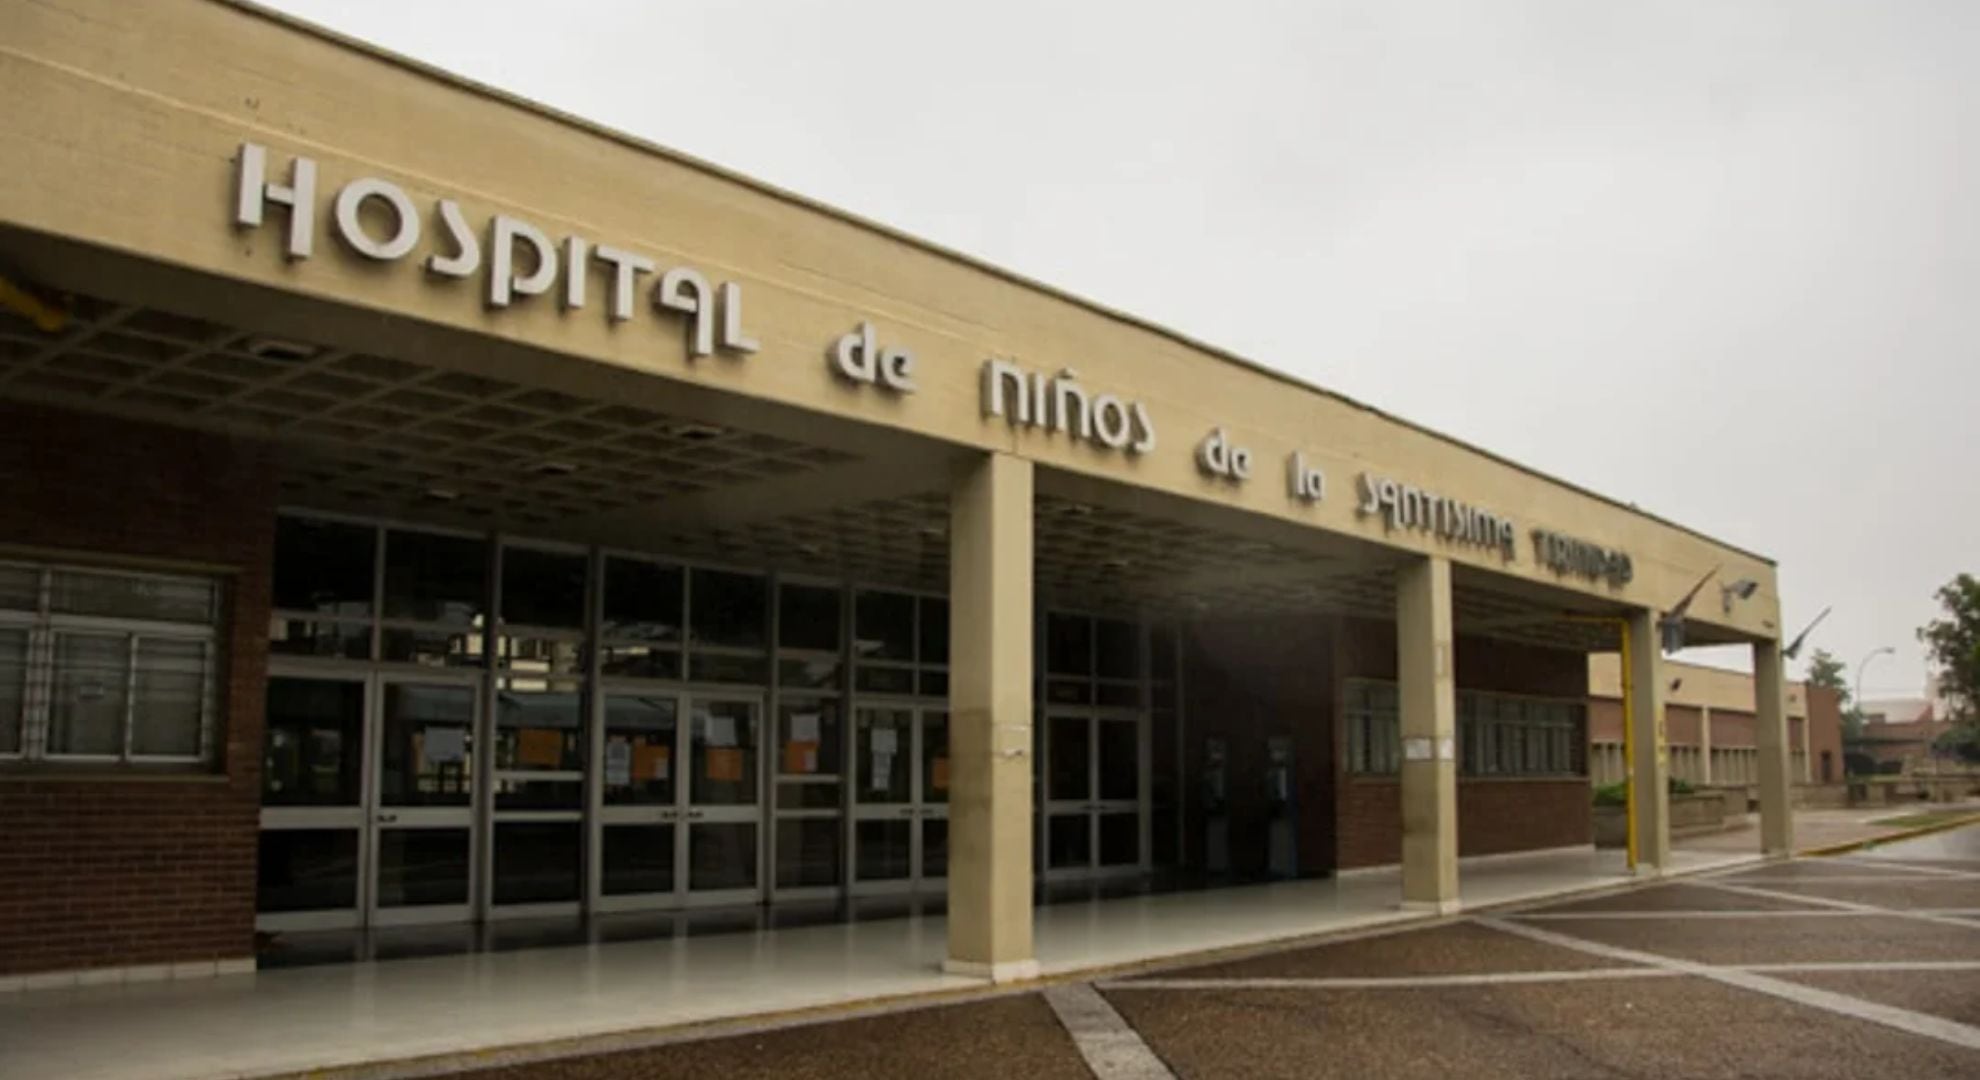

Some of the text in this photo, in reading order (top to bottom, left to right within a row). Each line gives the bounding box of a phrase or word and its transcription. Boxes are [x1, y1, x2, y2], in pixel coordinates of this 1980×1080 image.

[235, 142, 760, 358] HOSPITAL
[831, 321, 917, 394] de
[1199, 426, 1253, 482] de
[1289, 450, 1327, 501] la
